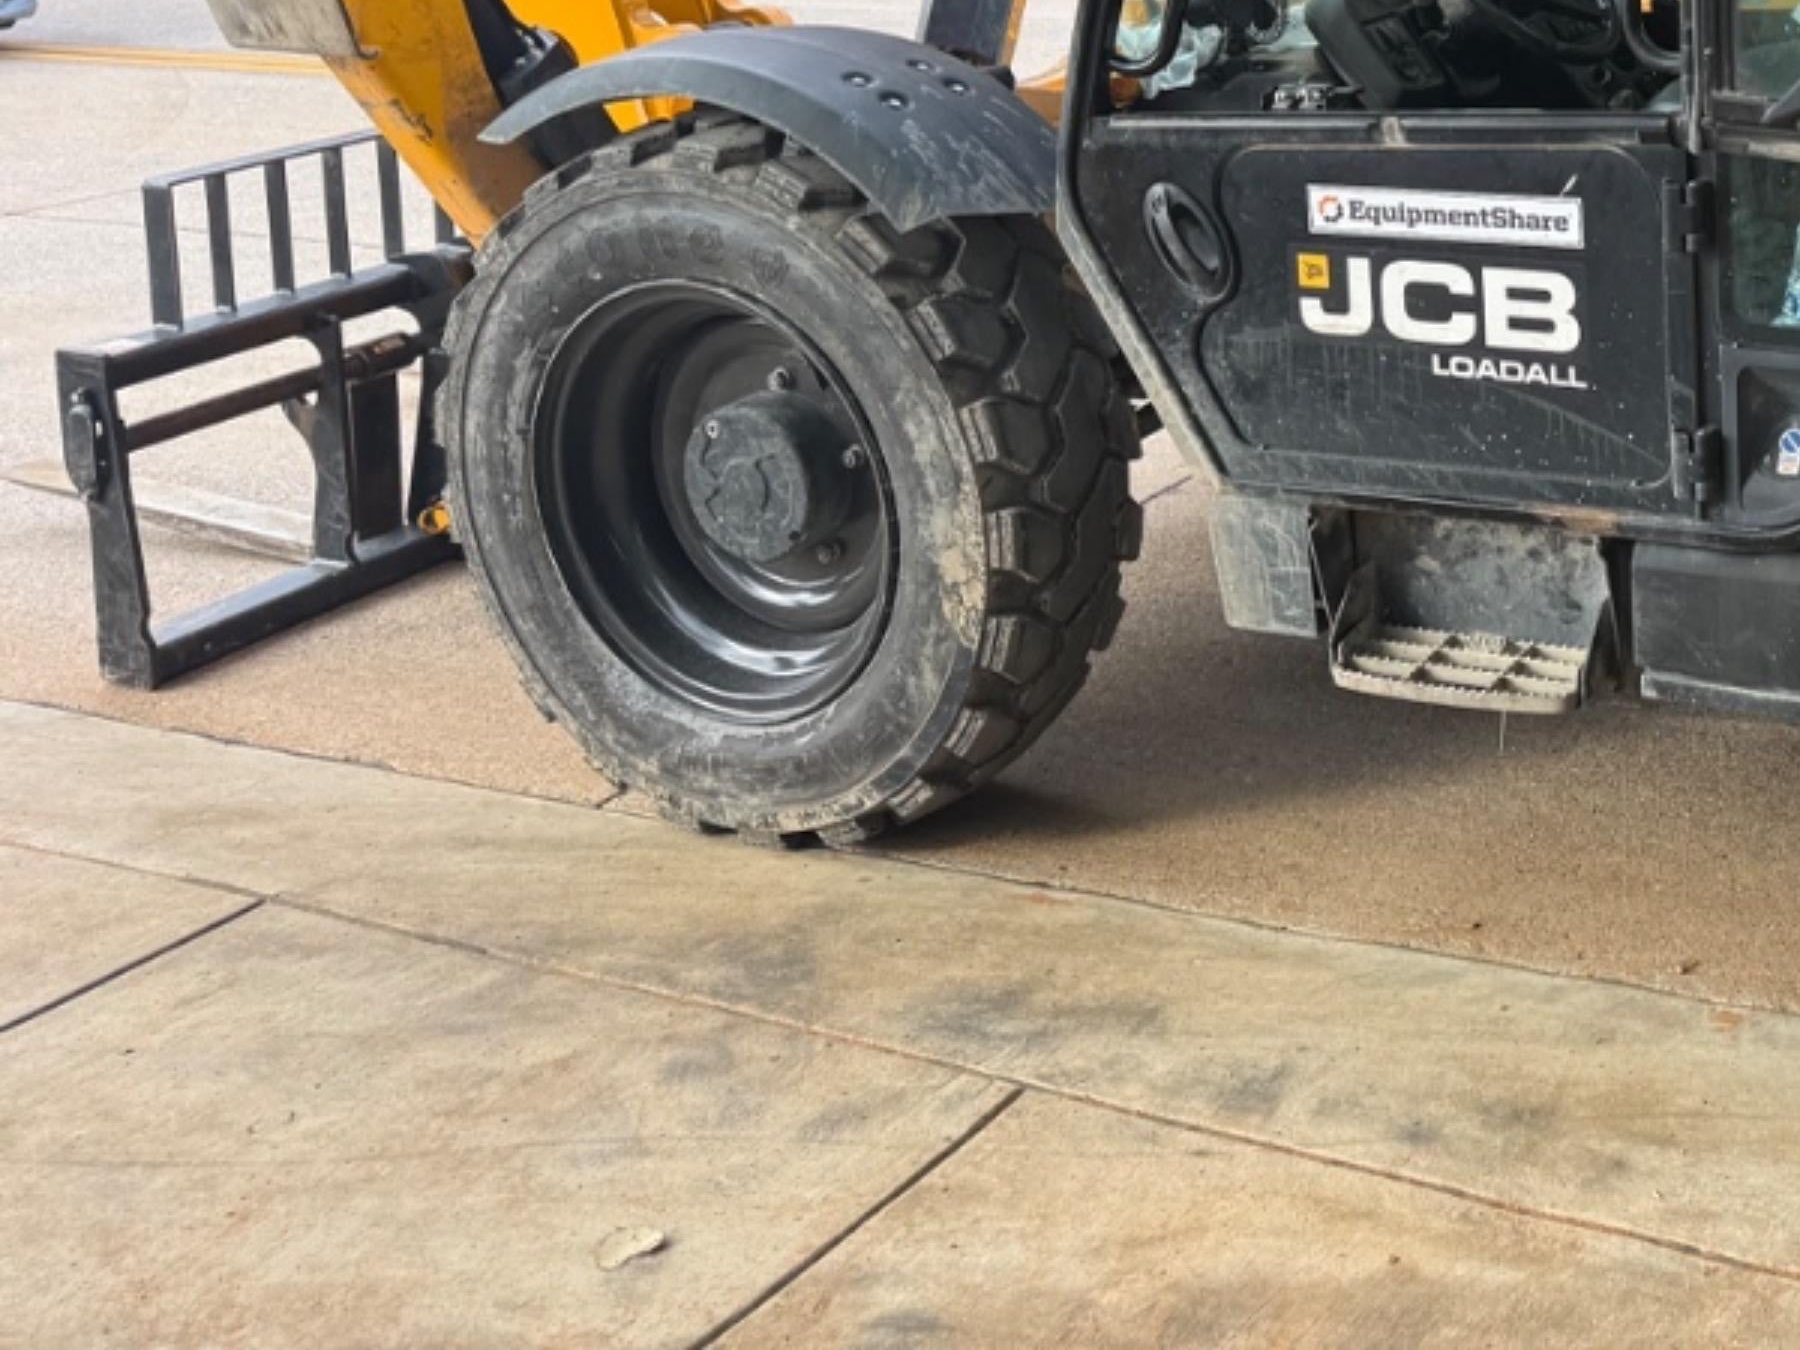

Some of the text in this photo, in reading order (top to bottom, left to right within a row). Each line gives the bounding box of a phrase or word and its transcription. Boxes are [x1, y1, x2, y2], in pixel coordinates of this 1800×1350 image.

[1349, 201, 1570, 232] EquipmentShare
[1299, 256, 1581, 353] JCB
[1431, 353, 1588, 388] LOADALL
